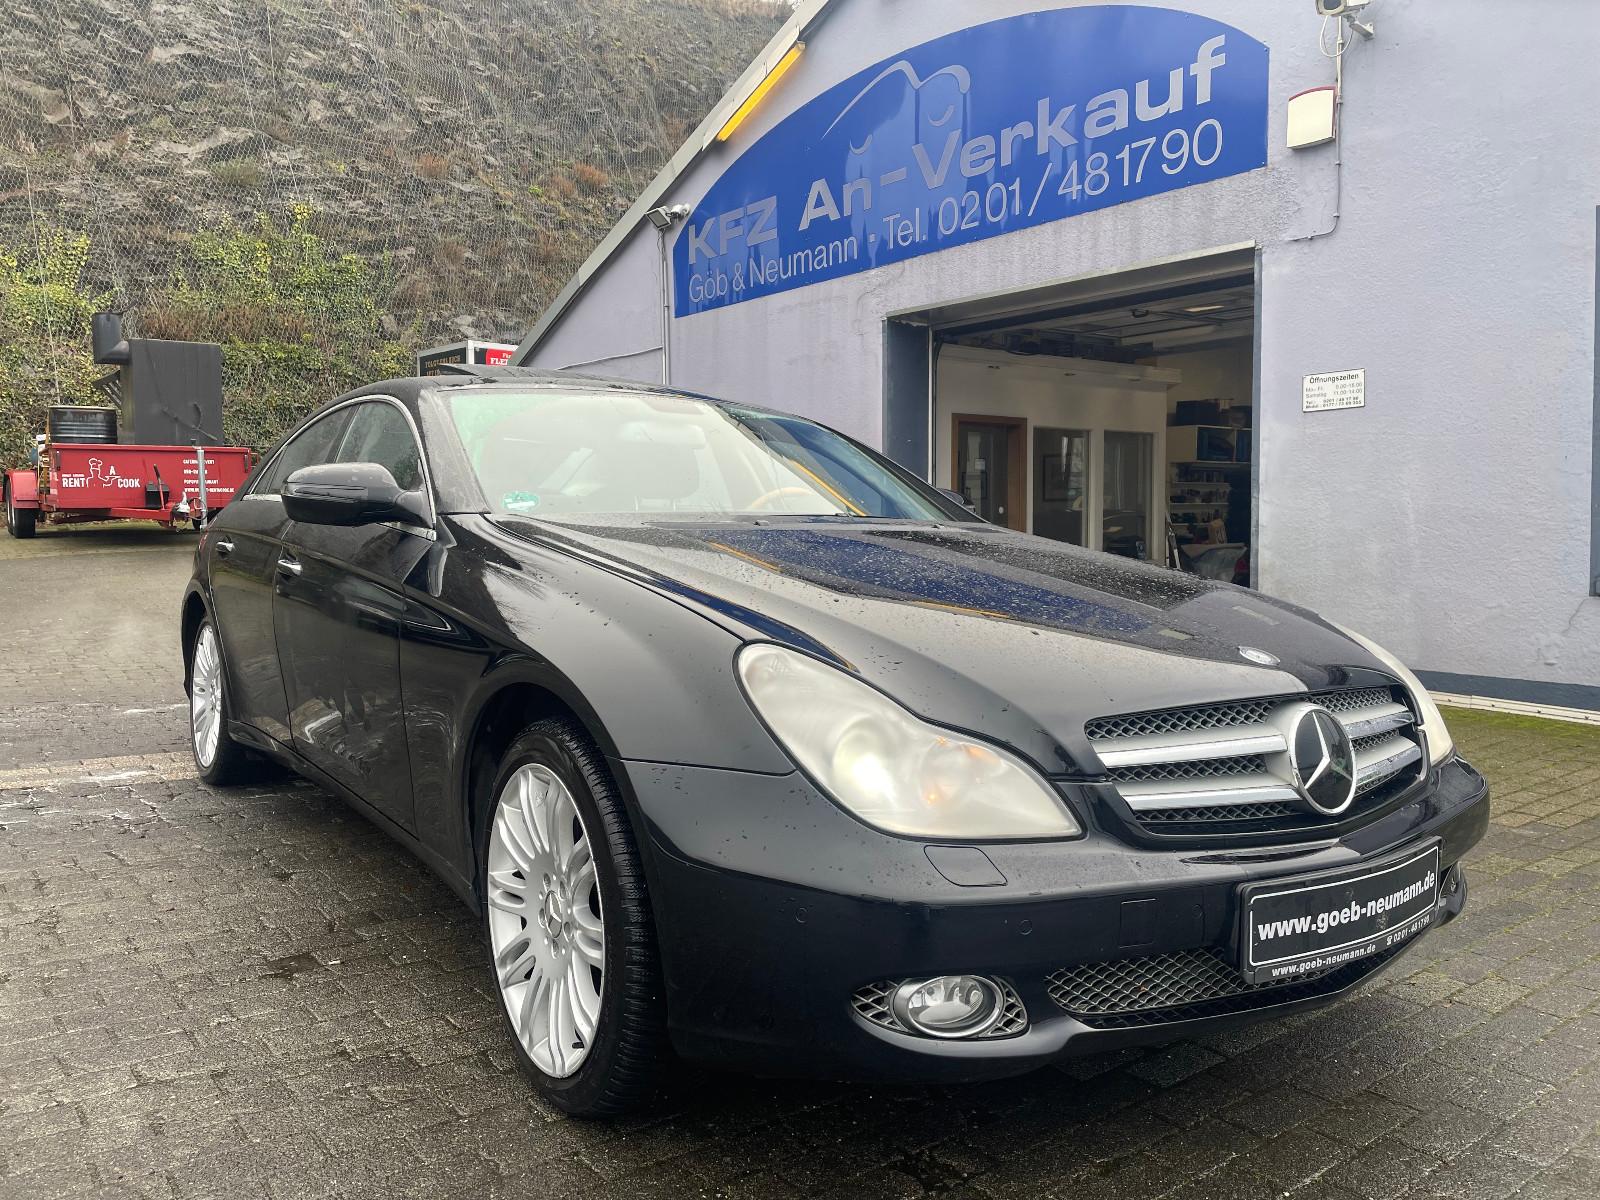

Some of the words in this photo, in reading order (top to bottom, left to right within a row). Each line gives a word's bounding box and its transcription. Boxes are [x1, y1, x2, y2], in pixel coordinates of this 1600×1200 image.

[688, 195, 777, 265] KFZ
[799, 34, 1226, 231] An-Verkauf
[689, 268, 728, 302] Göb
[733, 263, 746, 292] &
[749, 236, 858, 288] Neumann
[883, 207, 927, 249] Tel.
[1309, 373, 1359, 384] Öffnungszeiten
[62, 478, 85, 488] RENT
[109, 465, 116, 476] A
[117, 478, 141, 488] COOK
[1258, 870, 1435, 941] www.goeb-neumann.de
[1272, 944, 1376, 977] www.goeb-neumann.de
